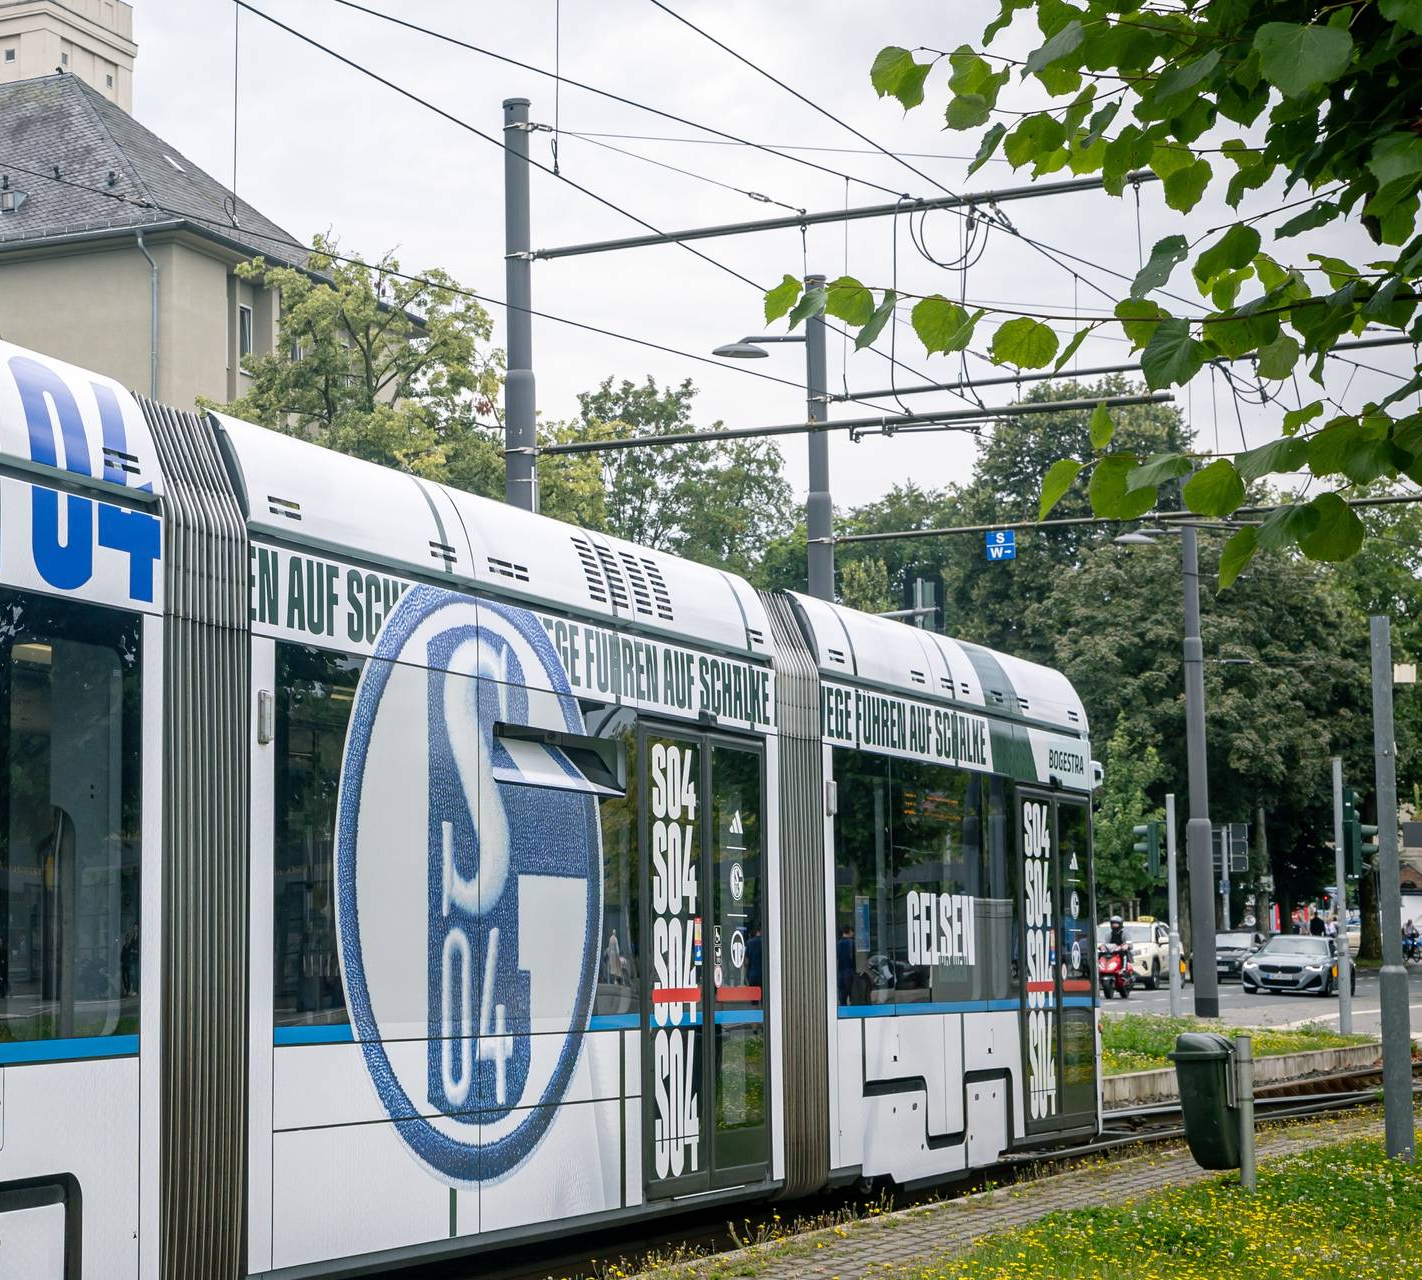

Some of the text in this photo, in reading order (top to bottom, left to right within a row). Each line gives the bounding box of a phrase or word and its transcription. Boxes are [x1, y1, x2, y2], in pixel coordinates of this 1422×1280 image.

[8, 356, 161, 603] 04
[989, 547, 1004, 559] W
[996, 532, 1005, 544] S
[287, 556, 339, 637] AUF
[584, 627, 659, 704] FÜHREN
[663, 649, 695, 710] AUF
[699, 655, 771, 726] SCHALKE
[855, 690, 907, 751] FÜHREN
[909, 705, 932, 755] AUF
[934, 709, 987, 766] SCHALKE
[1049, 749, 1084, 775] BOGESTRA
[652, 743, 697, 821] S04
[653, 820, 698, 915] S04
[907, 890, 976, 967] GELSEN
[655, 1028, 700, 1180] S04
